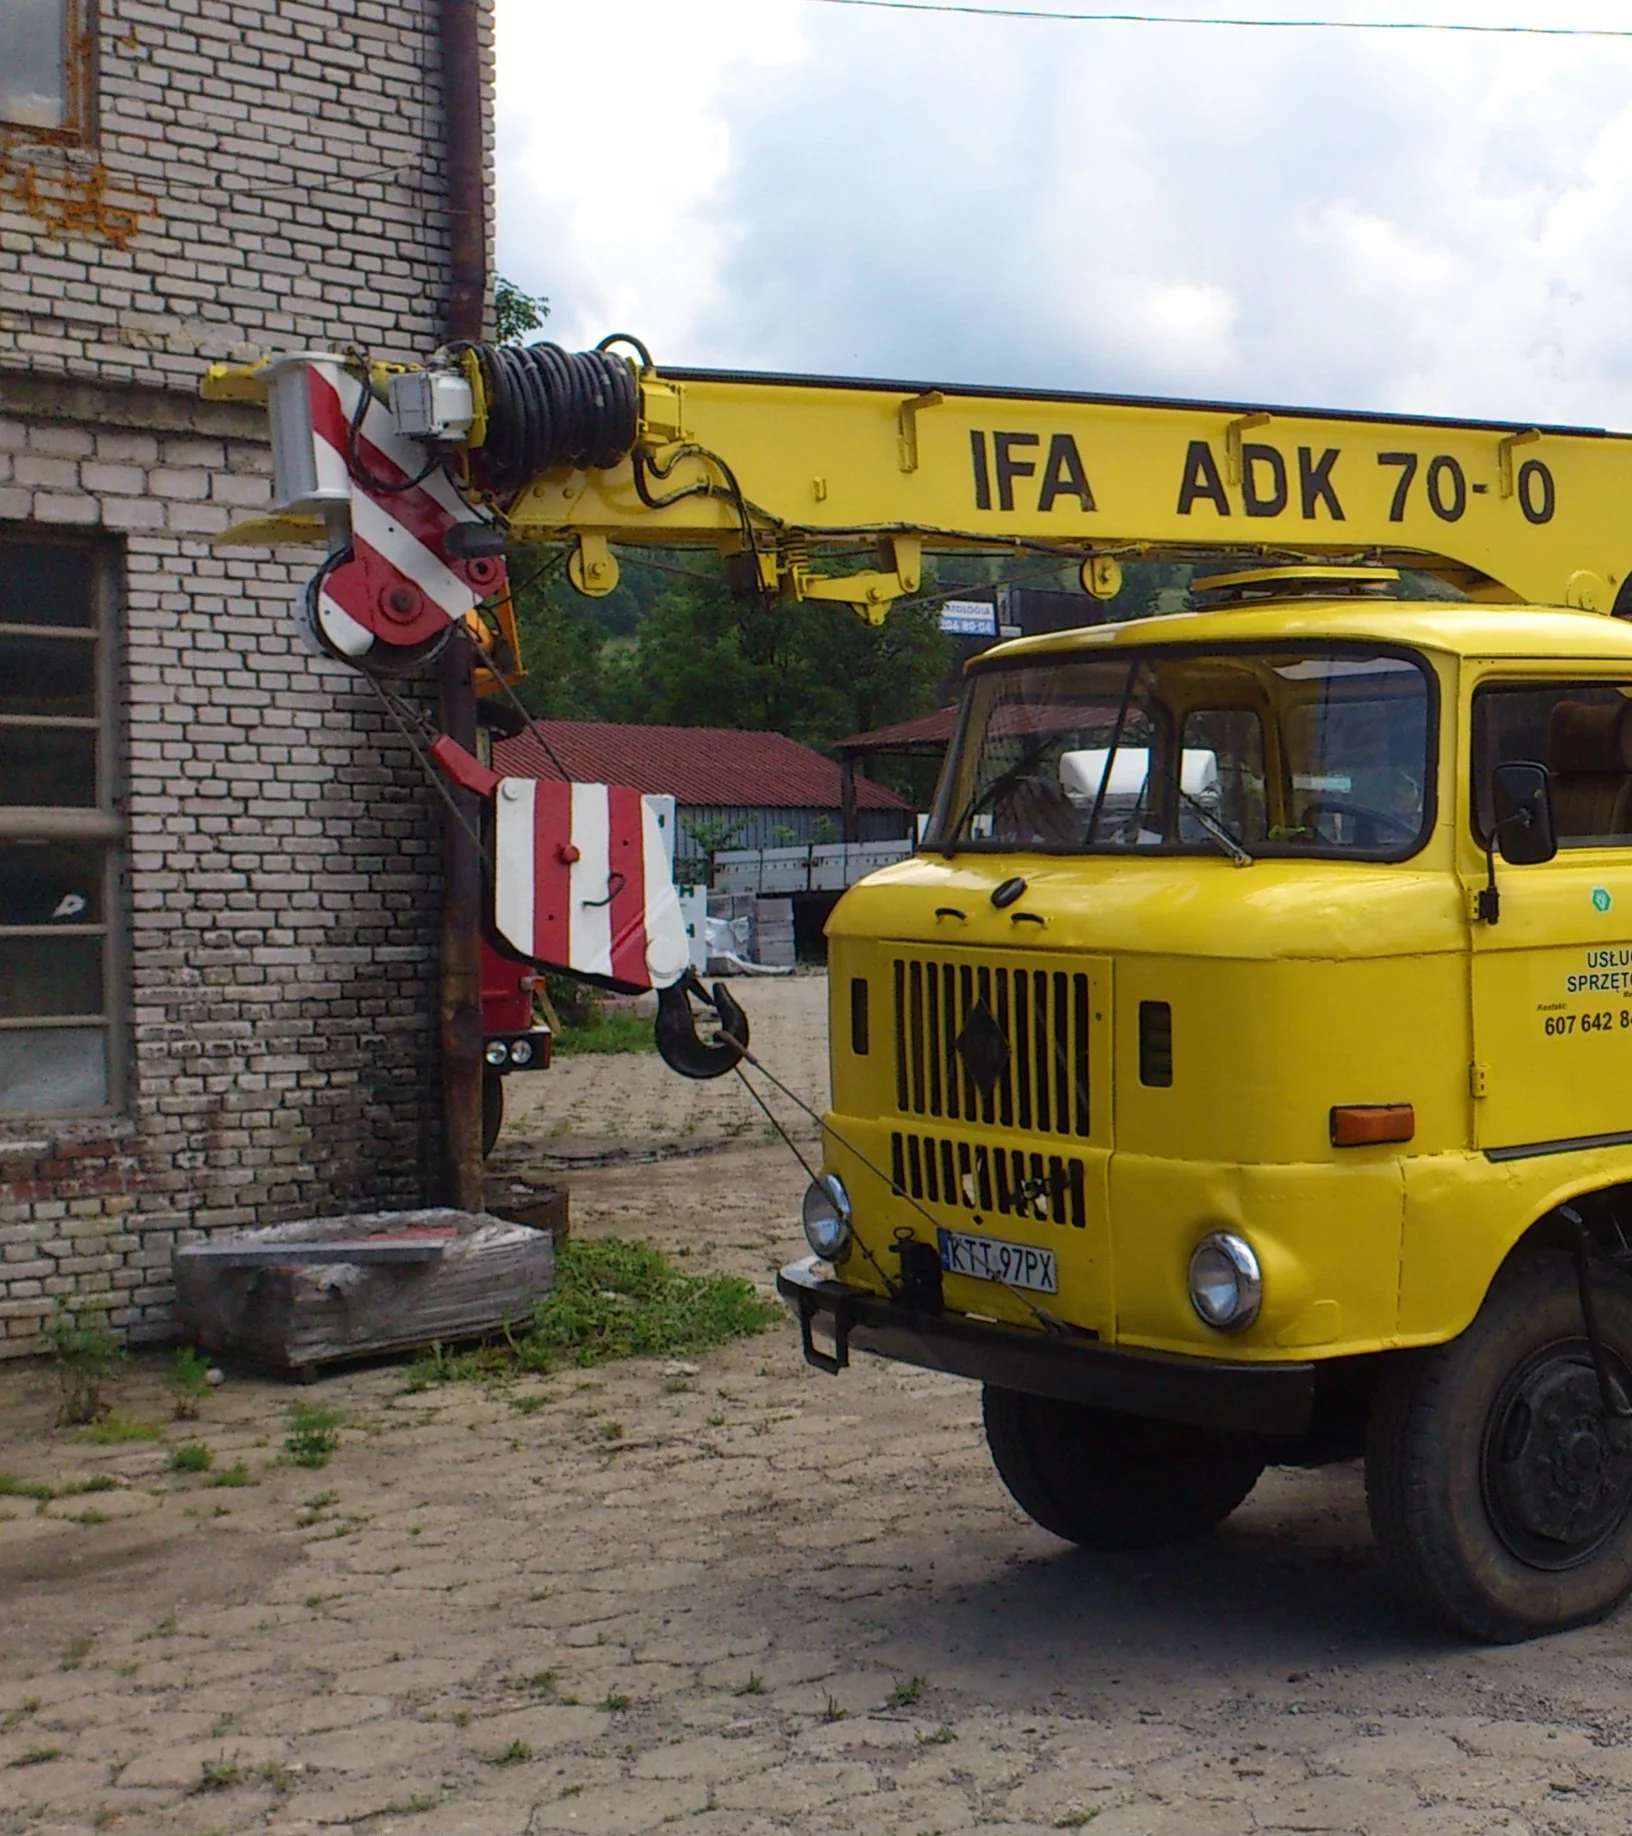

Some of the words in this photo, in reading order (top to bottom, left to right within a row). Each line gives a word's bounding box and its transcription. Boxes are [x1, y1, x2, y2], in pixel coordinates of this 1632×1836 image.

[970, 429, 1098, 512] IFA
[1177, 440, 1346, 521] ADK
[1545, 1015, 1577, 1036] 607
[1581, 1012, 1613, 1033] 642
[950, 1236, 995, 1277] KTT
[1000, 1246, 1053, 1289] 97PX
